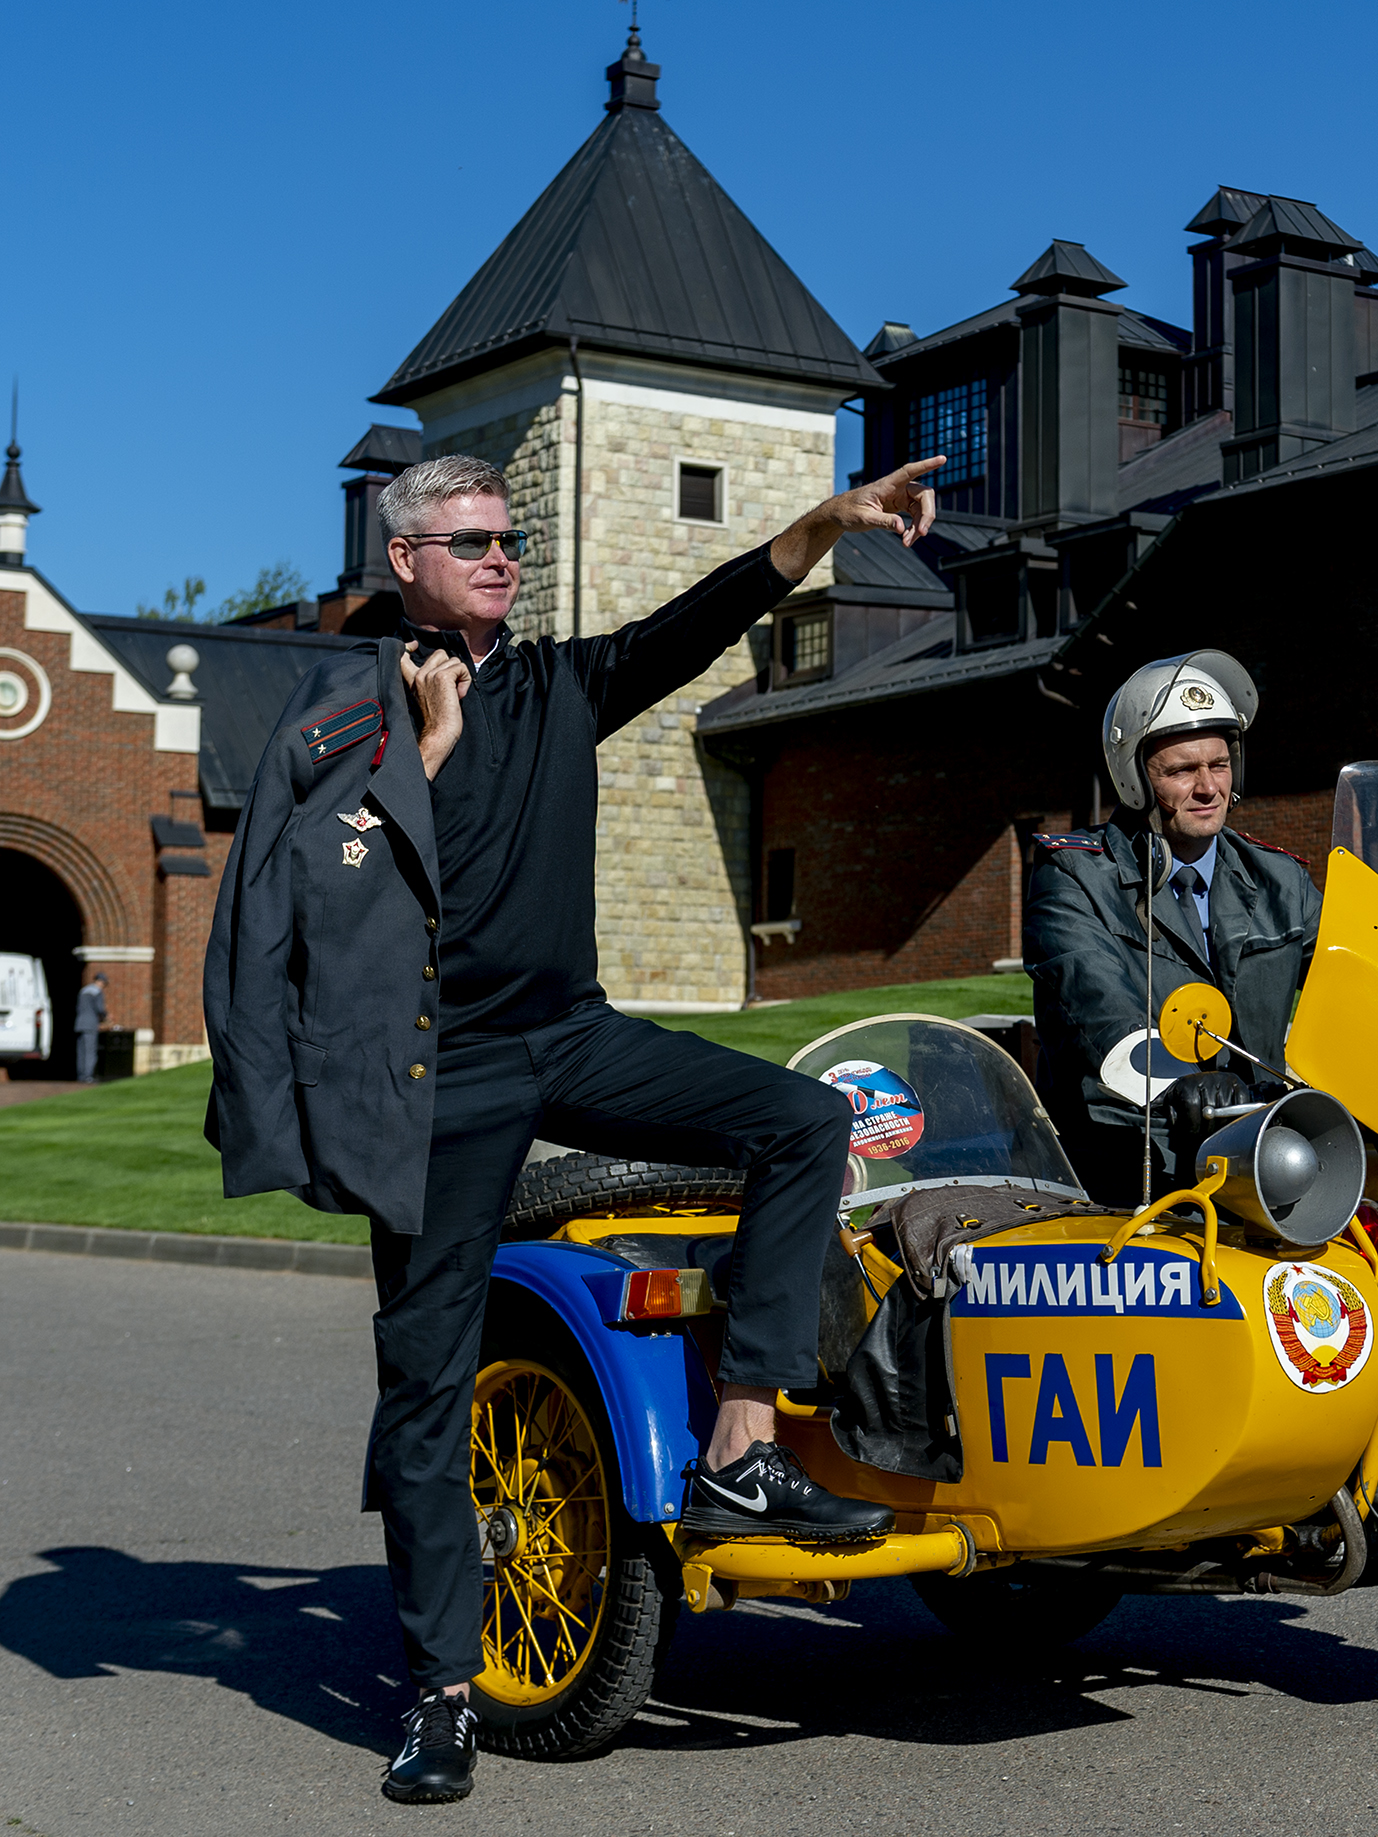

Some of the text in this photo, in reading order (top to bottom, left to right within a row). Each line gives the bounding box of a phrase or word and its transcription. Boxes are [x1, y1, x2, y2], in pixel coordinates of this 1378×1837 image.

[828, 1072, 839, 1084] 3
[870, 1092, 908, 1110] лет
[852, 1111, 898, 1131] НА СТРАЖЕ
[867, 1137, 911, 1155] 1936-2016
[967, 1262, 1191, 1313] МИЛИЦИЯ
[984, 1353, 1162, 1468] ГАИ
